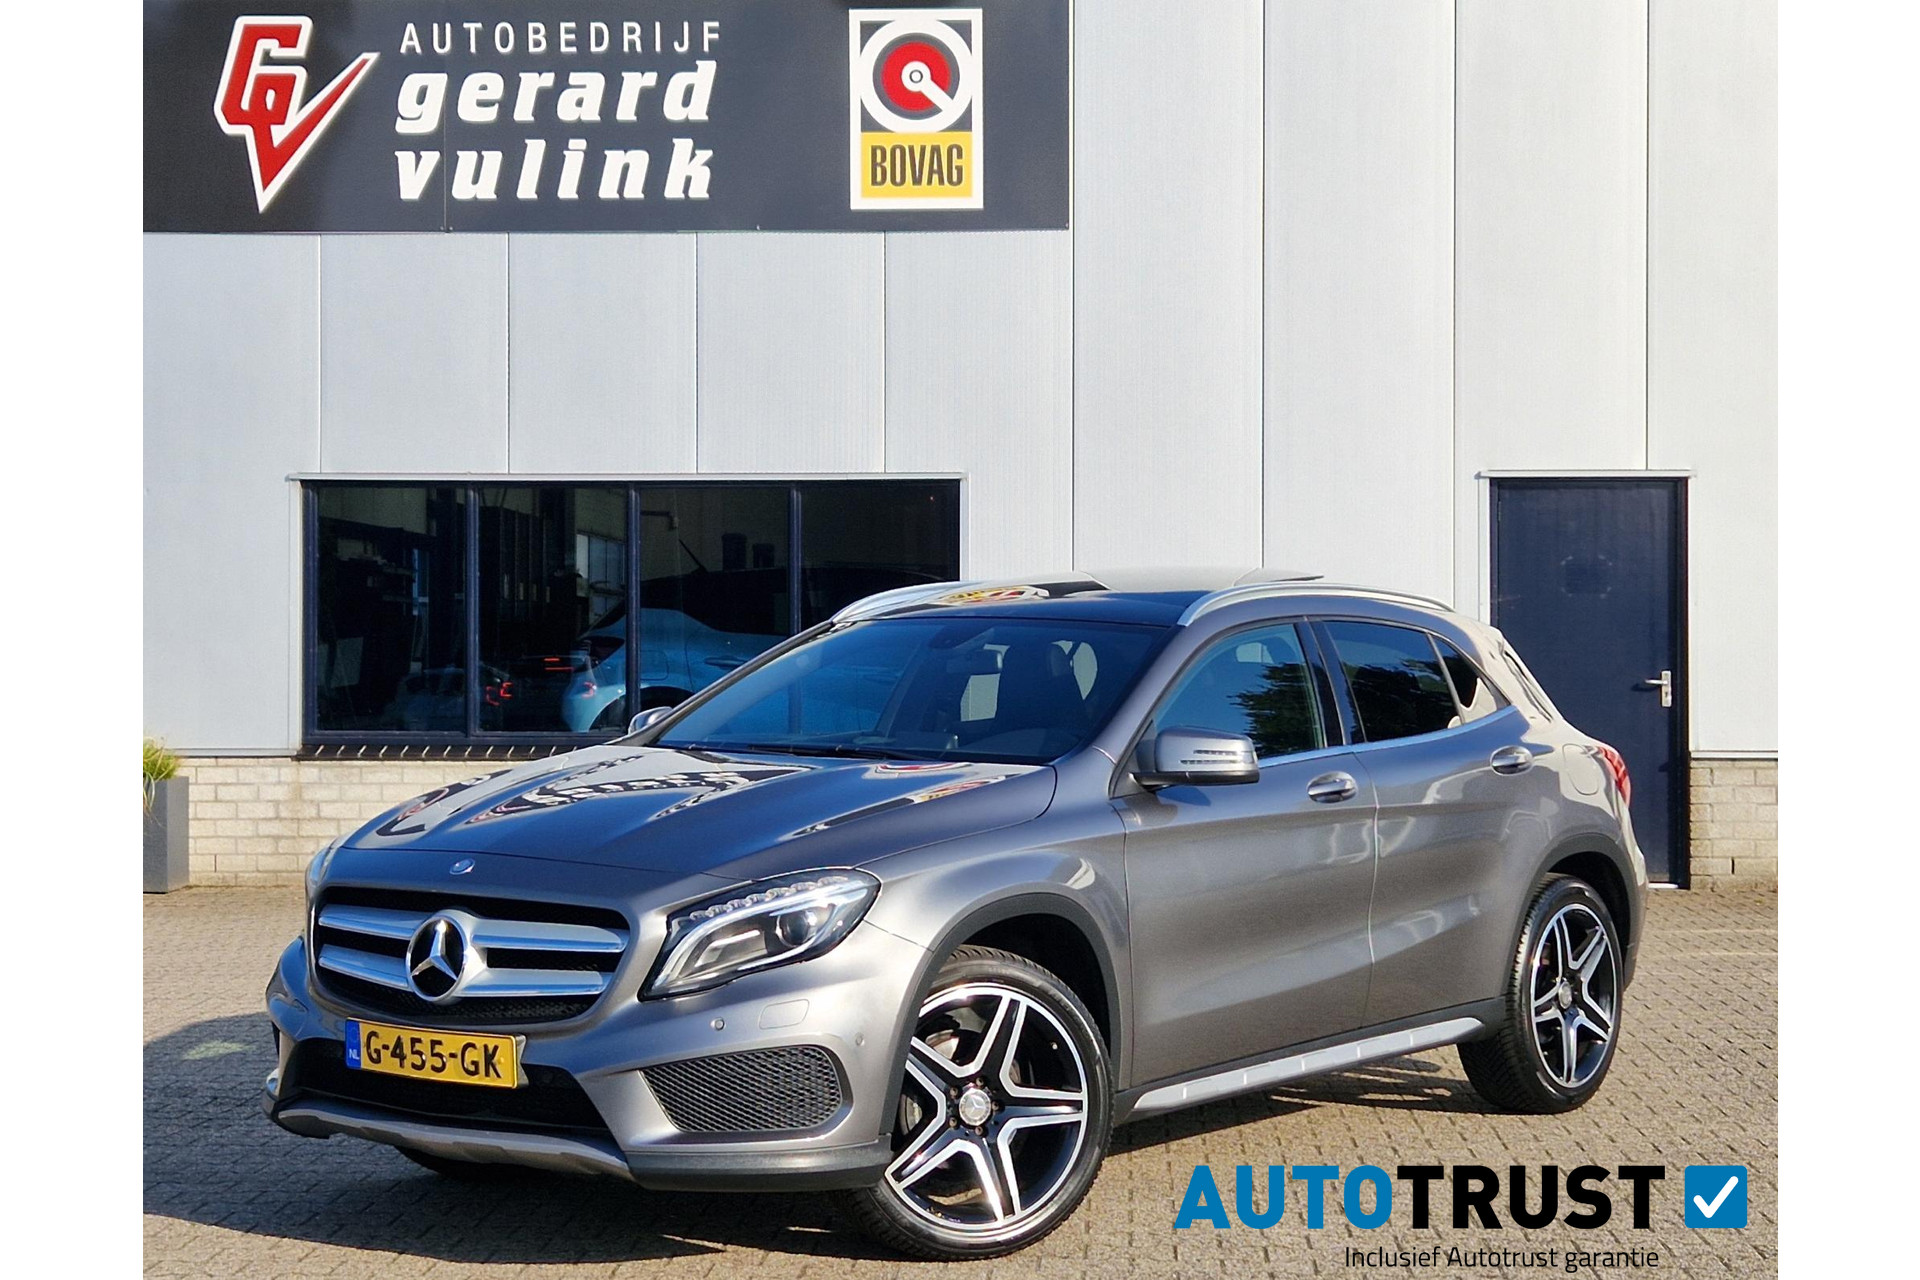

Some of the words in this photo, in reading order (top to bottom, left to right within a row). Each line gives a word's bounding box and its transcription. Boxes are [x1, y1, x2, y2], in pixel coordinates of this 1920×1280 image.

[400, 21, 721, 53] AUTOBEDRIJF
[395, 60, 717, 134] gerard
[394, 139, 714, 200] vulink
[870, 144, 964, 187] BOVAG
[349, 1048, 360, 1060] NL
[366, 1031, 501, 1078] G-455-GK
